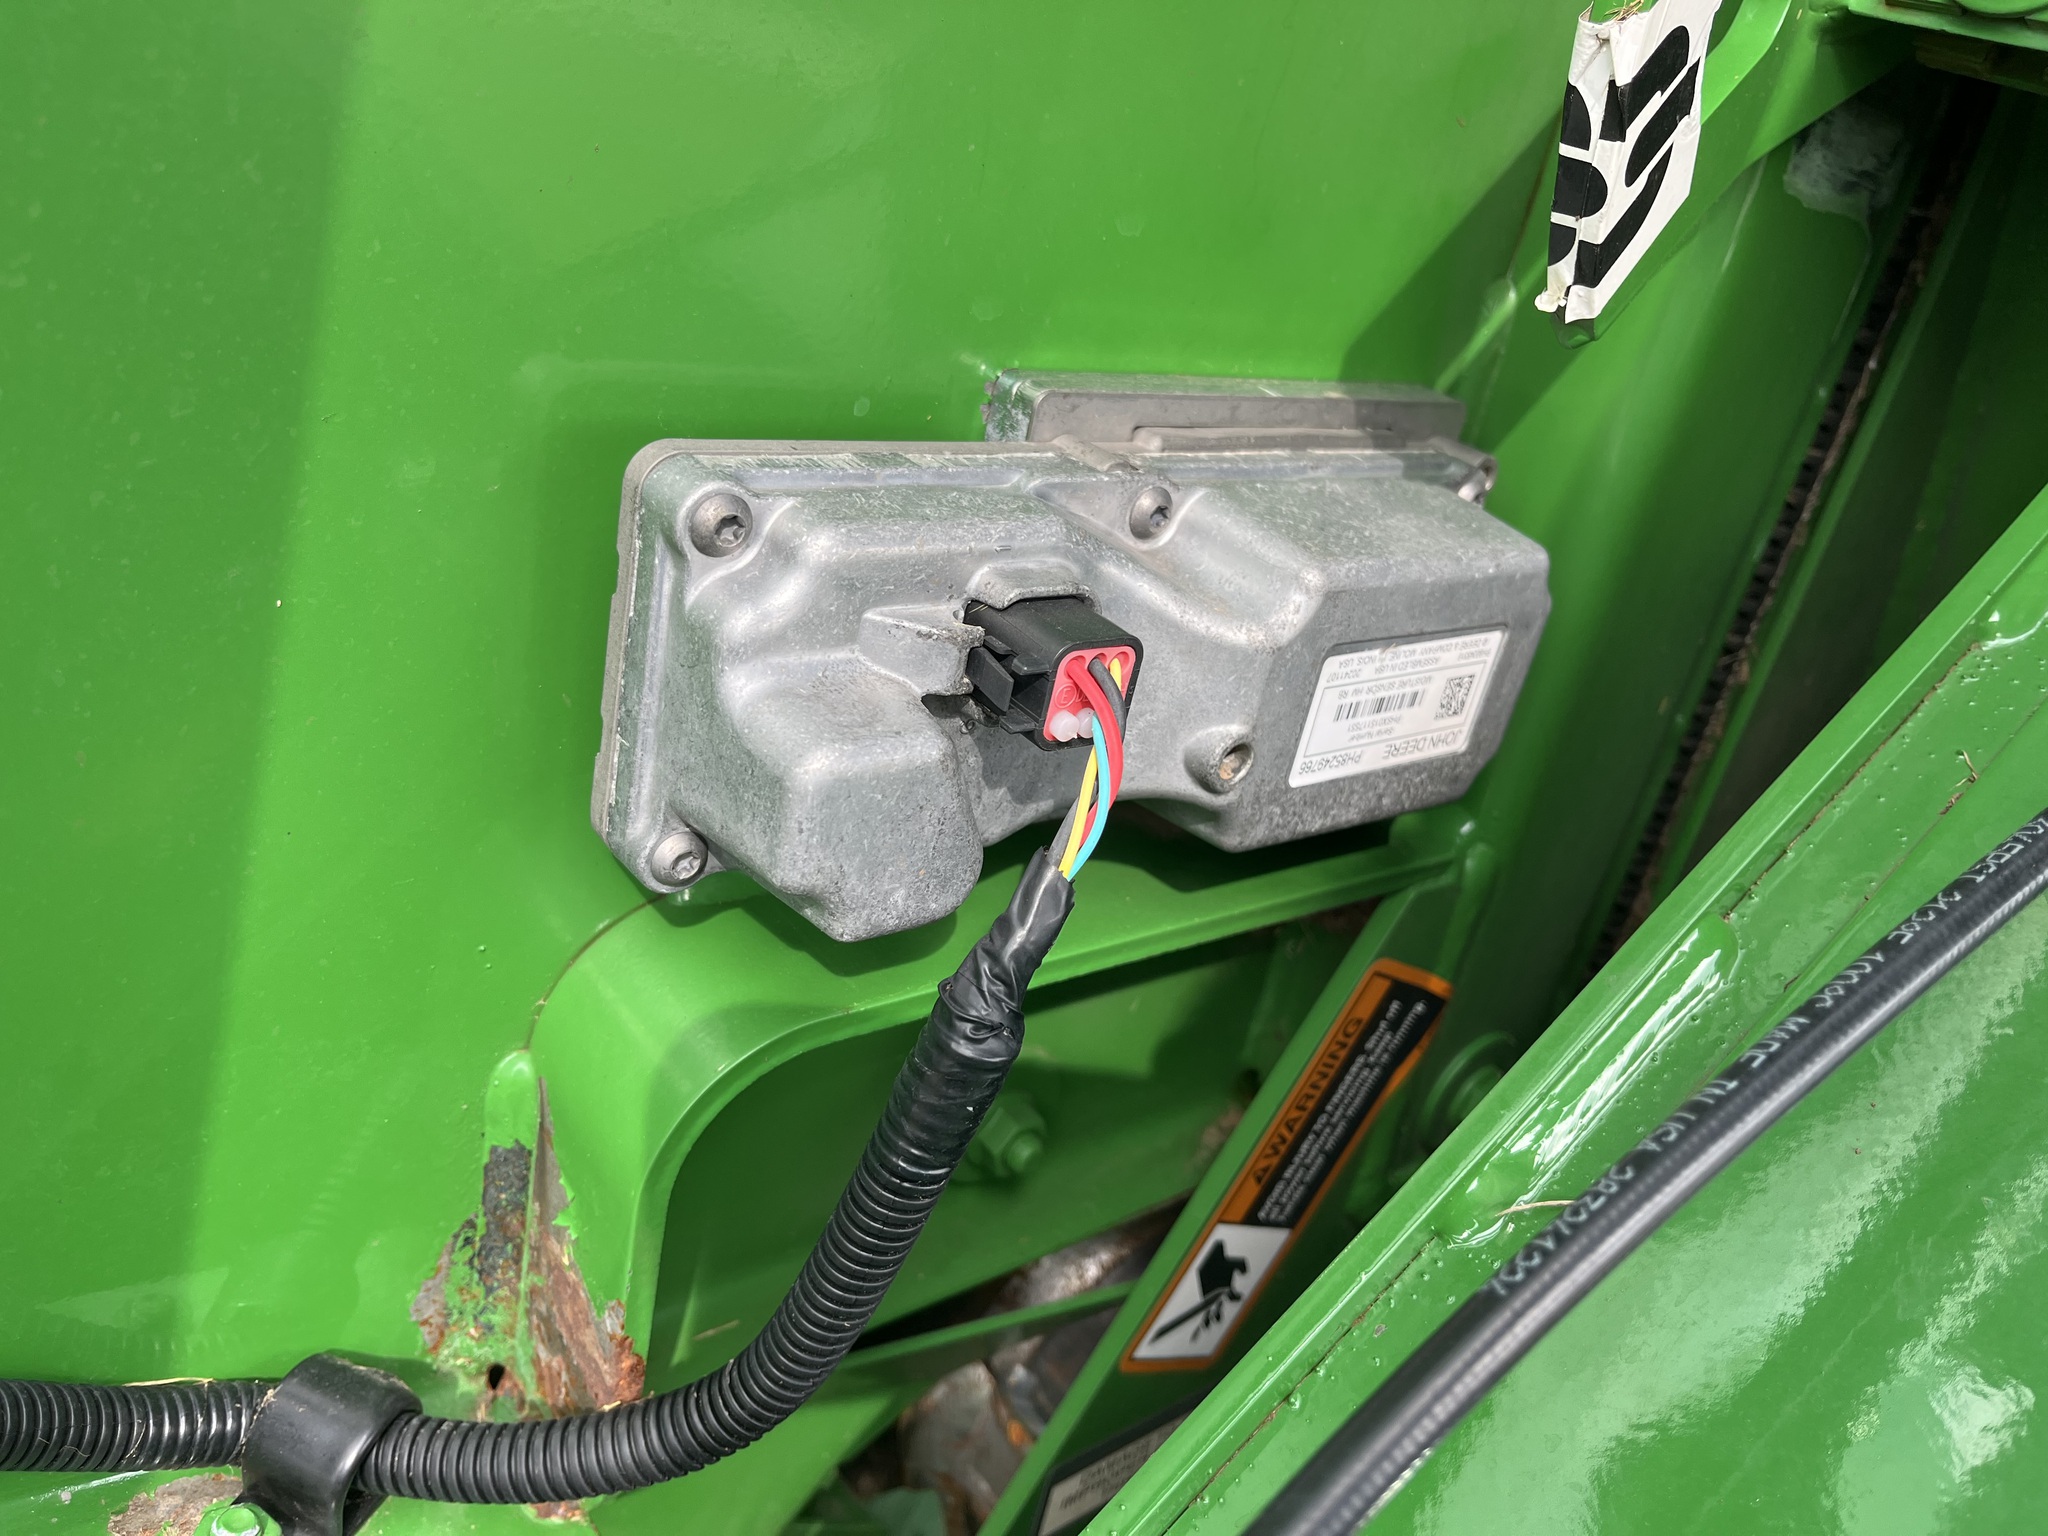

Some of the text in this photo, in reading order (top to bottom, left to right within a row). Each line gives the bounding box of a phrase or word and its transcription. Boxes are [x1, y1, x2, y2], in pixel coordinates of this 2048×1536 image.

[1365, 681, 1396, 694] SENSOR
[1381, 729, 1462, 759] JOHN DEERE
[1270, 1017, 1363, 1156] WARNING
